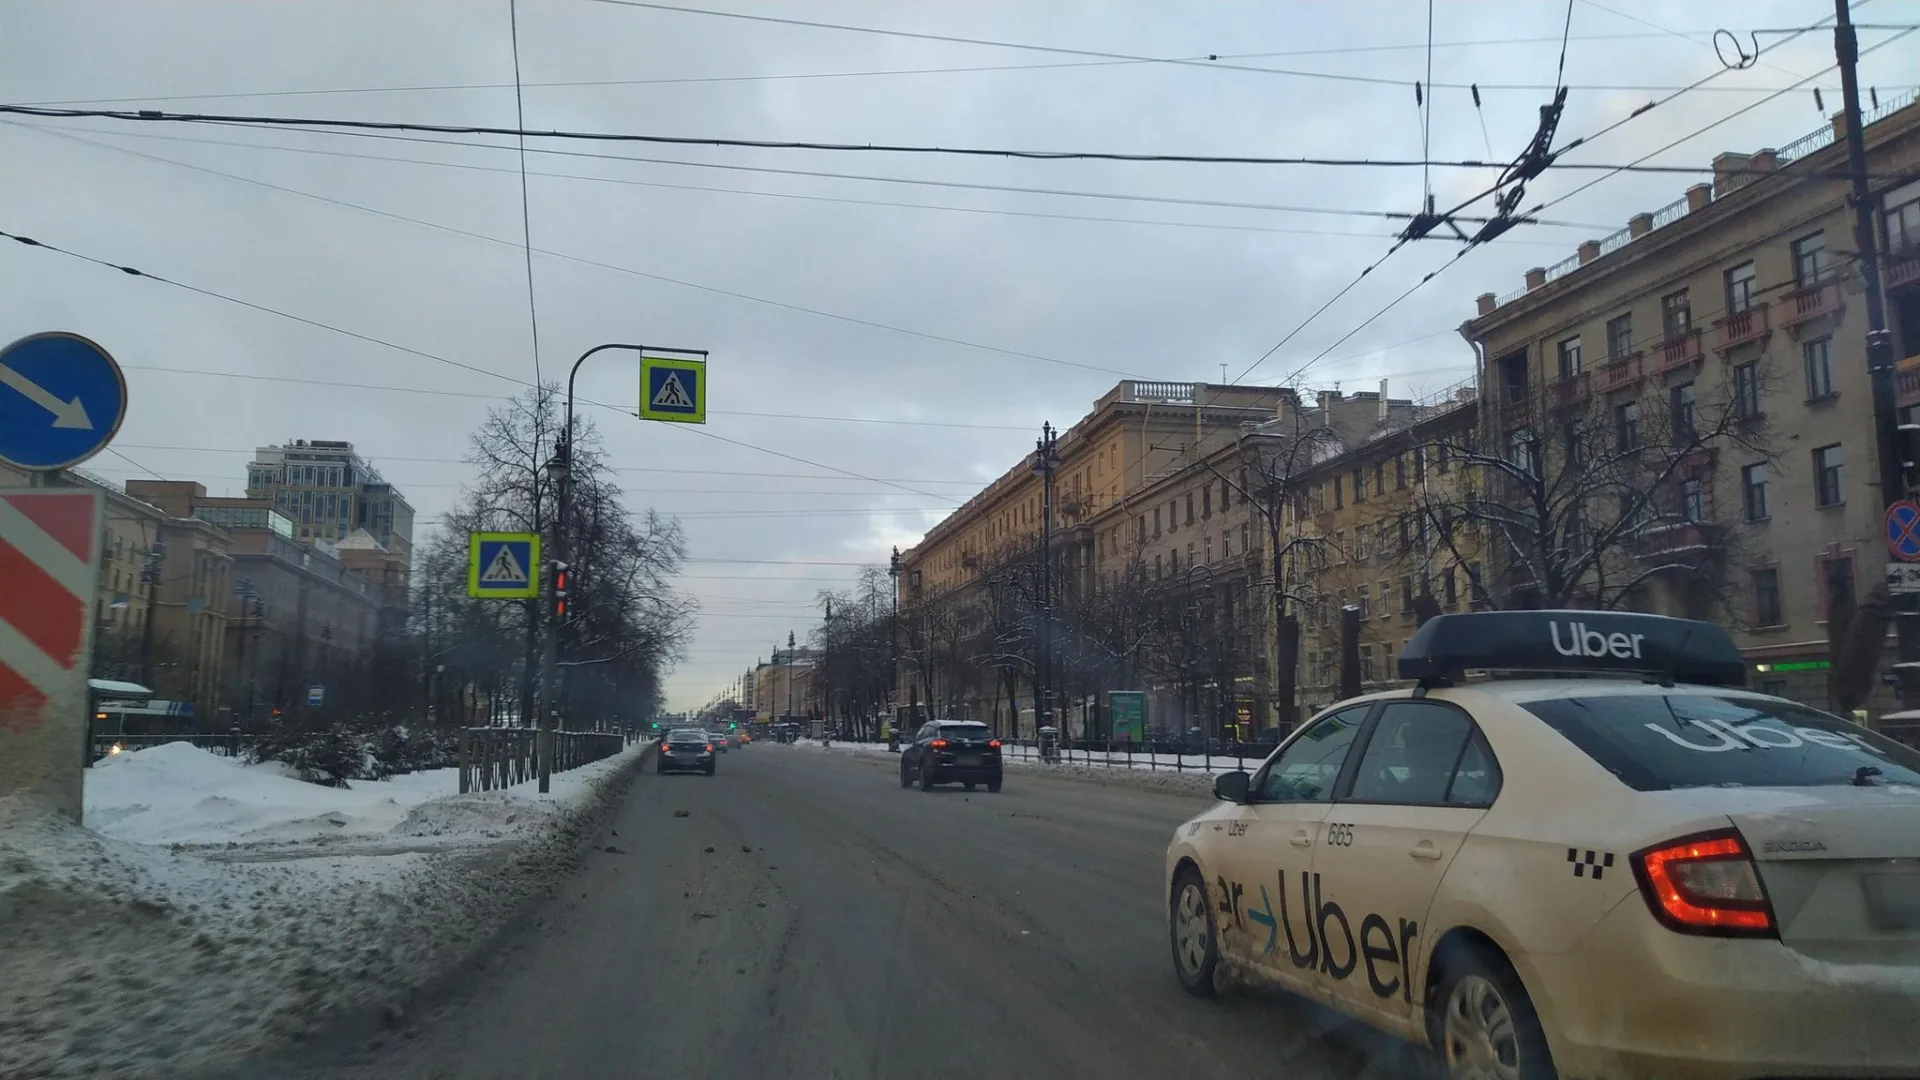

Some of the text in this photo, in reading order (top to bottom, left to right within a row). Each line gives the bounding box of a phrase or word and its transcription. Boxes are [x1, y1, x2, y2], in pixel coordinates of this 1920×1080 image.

[1549, 621, 1645, 659] Uber
[1644, 718, 1886, 754] Uber
[1228, 820, 1249, 837] Uber
[1327, 823, 1355, 848] 665
[1278, 869, 1418, 1004] Uber
